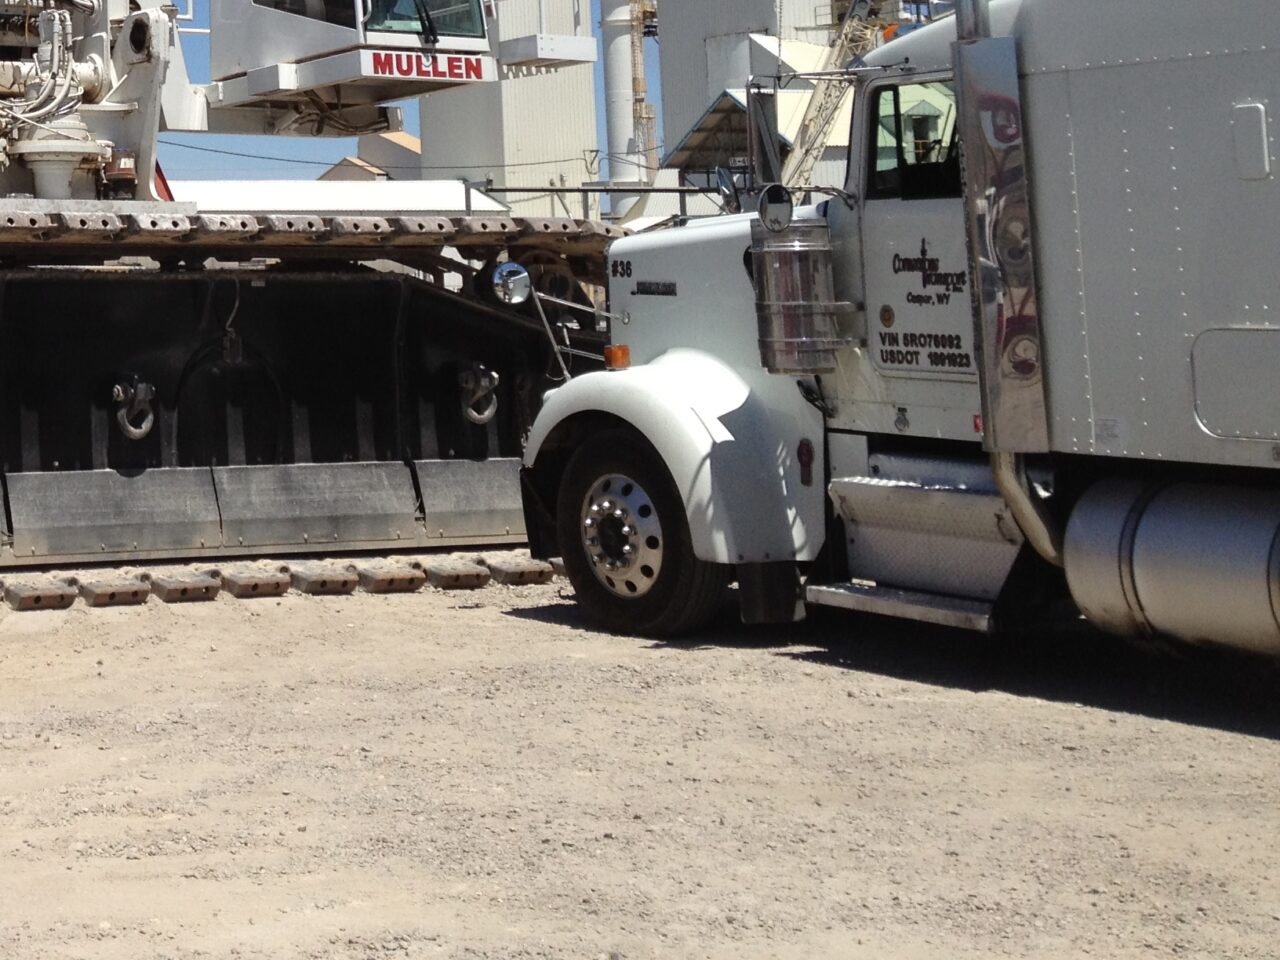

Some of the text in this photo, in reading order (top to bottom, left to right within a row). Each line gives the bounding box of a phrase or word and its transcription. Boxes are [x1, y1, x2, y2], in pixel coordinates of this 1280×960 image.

[372, 52, 483, 80] MULLEN
[611, 260, 633, 278] #36
[881, 349, 920, 365] USDOT
